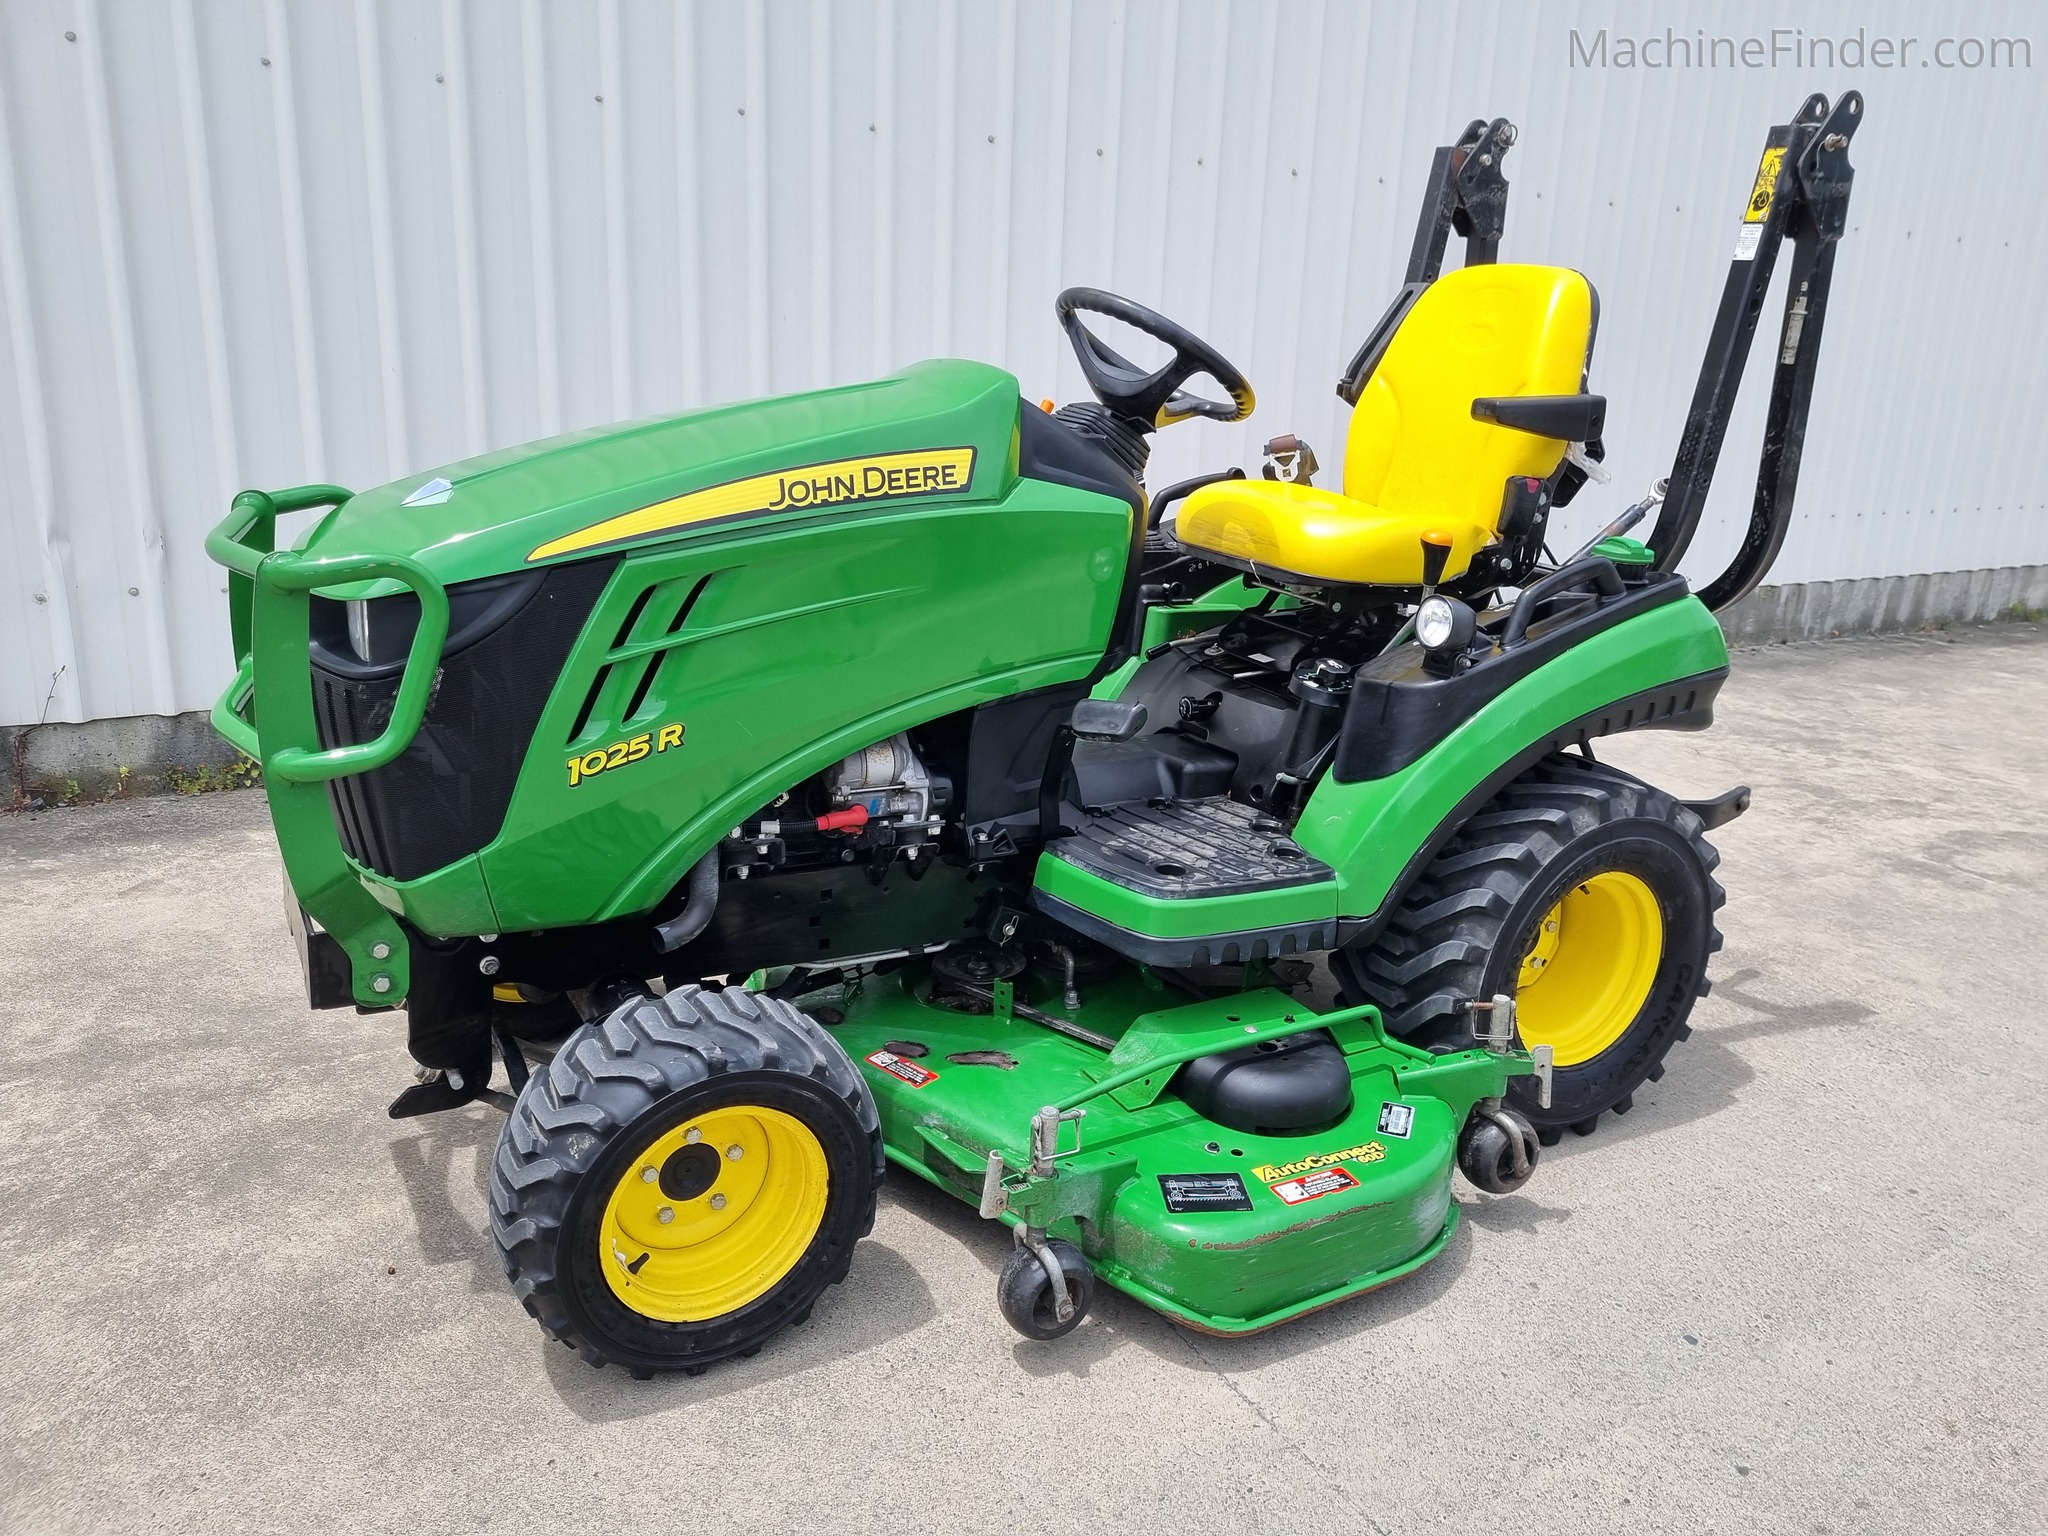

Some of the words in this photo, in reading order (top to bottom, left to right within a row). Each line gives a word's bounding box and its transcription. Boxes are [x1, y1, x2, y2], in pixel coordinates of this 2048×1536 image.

[768, 473, 855, 508] JOHN
[863, 464, 958, 495] DEERE
[567, 732, 653, 787] 1025
[658, 723, 686, 754] R
[1263, 1140, 1386, 1182] AutoConnect
[1356, 1151, 1386, 1165] 60D
